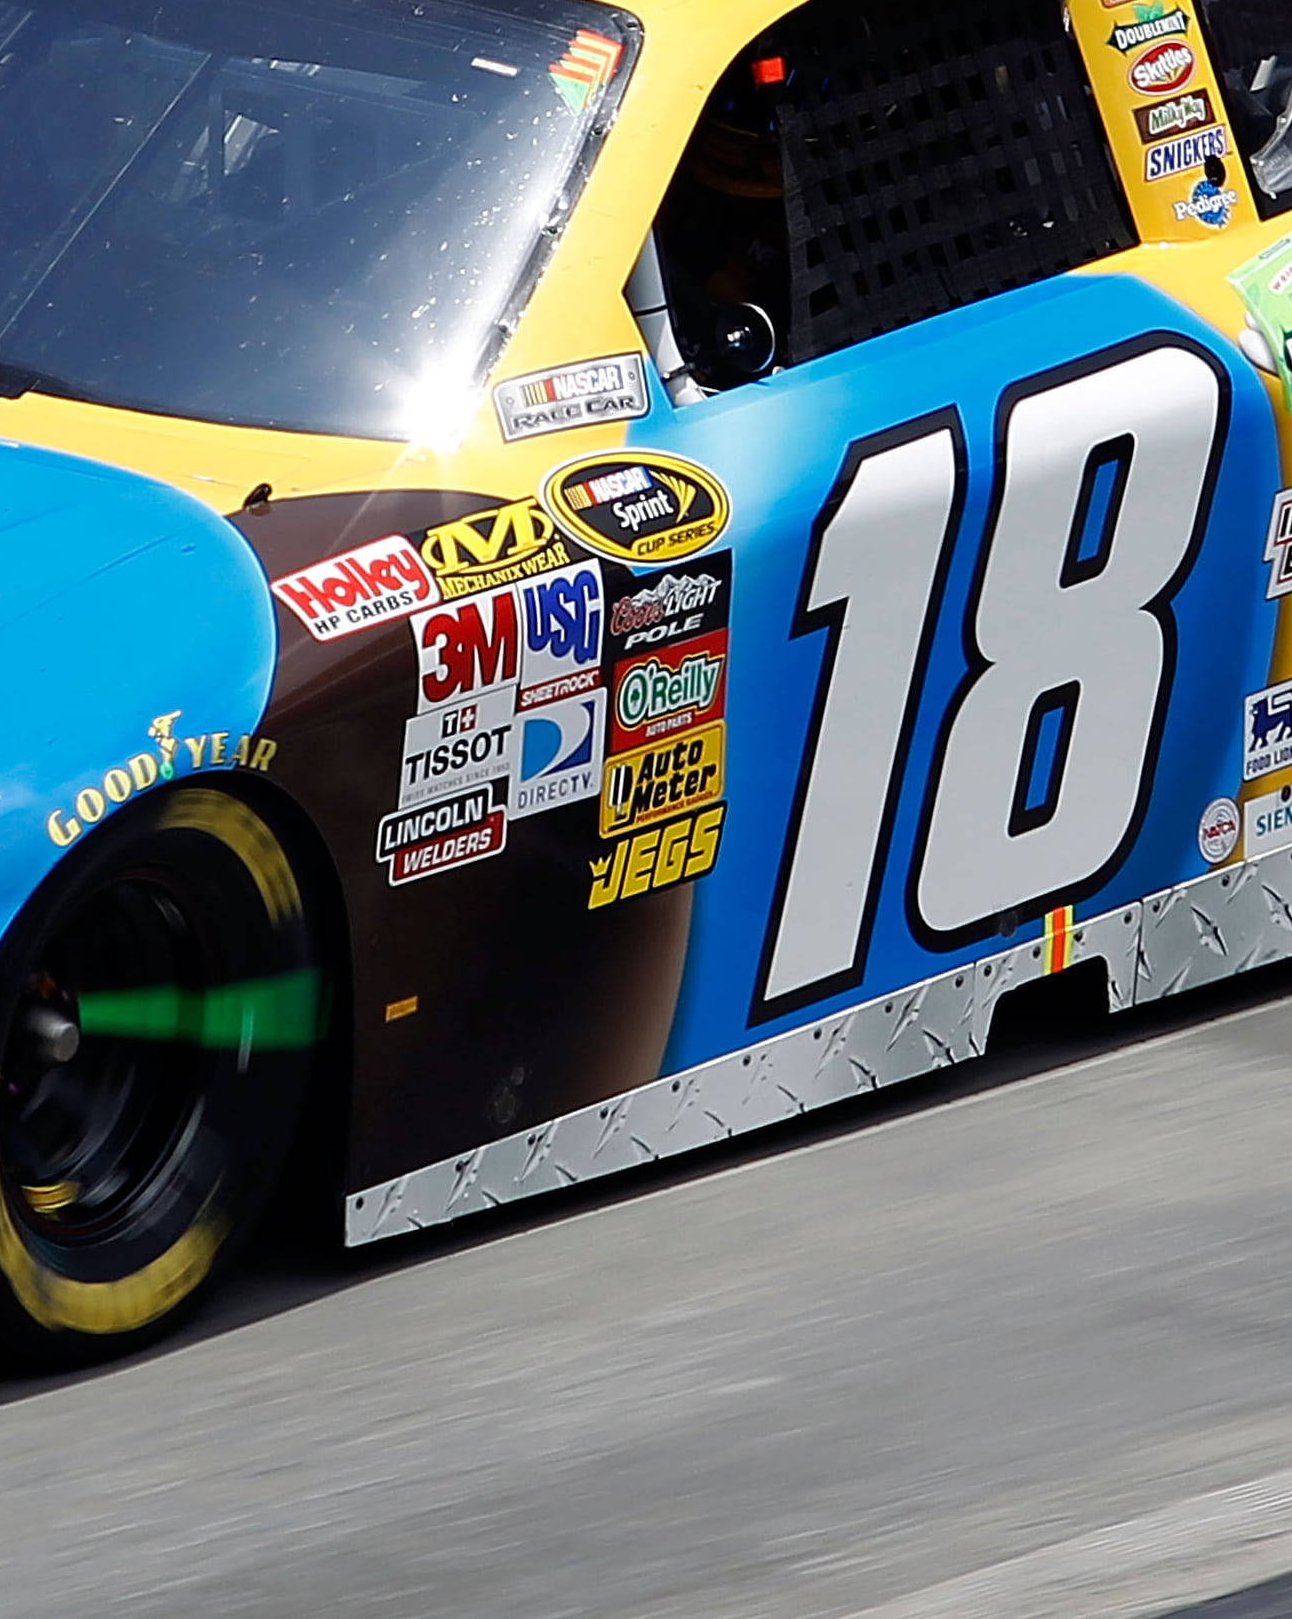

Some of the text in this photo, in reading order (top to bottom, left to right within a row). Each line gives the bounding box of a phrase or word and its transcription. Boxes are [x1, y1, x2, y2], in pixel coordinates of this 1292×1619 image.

[1115, 11, 1188, 50] DOUBLEMINT
[1134, 47, 1193, 88] Skittles
[1149, 128, 1225, 178] SNICKERS
[1174, 190, 1238, 221] Pedigree
[555, 364, 623, 401] NASCAR
[513, 394, 636, 429] RACE CAR
[588, 465, 650, 504] NASCAR
[613, 490, 675, 531] Sprint
[637, 522, 716, 556] CUP SERIES
[278, 548, 431, 619] Holley
[437, 541, 570, 600] MECHANIX WEAR
[314, 590, 414, 635] HP CARBS
[523, 569, 602, 665] USG
[610, 579, 723, 636] Coors LIGHT
[421, 595, 519, 703] 3M
[623, 613, 704, 651] POLE
[520, 669, 600, 708] SHEETROCK
[619, 655, 723, 728] O'Reilly
[754, 337, 1225, 1014] 18
[405, 724, 512, 786] TISSOT
[637, 739, 705, 785] Auto
[1247, 755, 1272, 776] FOOD
[517, 772, 593, 810] DIRECTV
[633, 764, 717, 814] Meter
[385, 795, 484, 851] LINCOLN
[402, 827, 493, 874] WELDERS
[588, 805, 724, 910] JEGS
